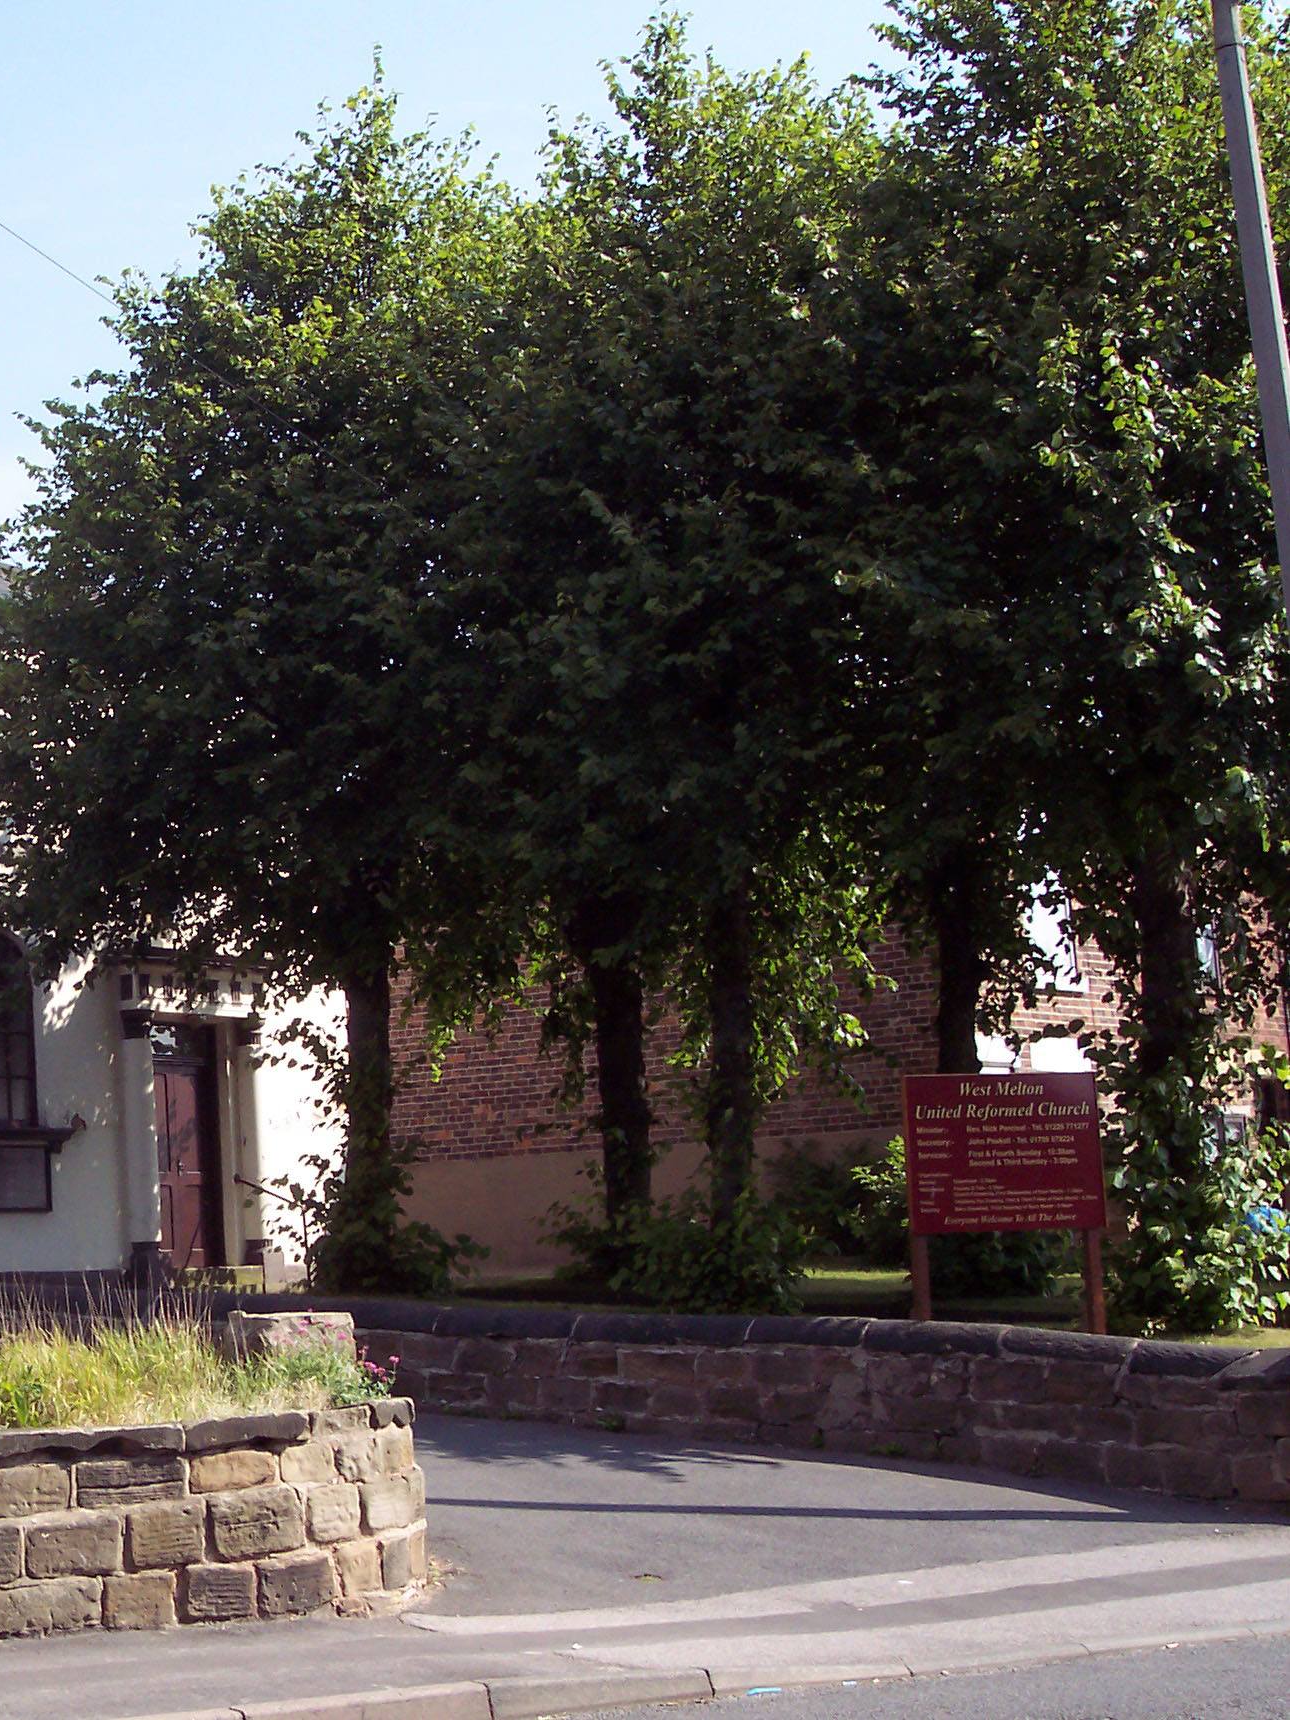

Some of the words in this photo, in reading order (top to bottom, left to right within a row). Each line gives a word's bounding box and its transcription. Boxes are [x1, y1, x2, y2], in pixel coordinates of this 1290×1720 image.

[960, 1082, 991, 1096] West
[995, 1081, 1044, 1096] Melton
[916, 1104, 962, 1120] United
[966, 1102, 1034, 1121] Reformed
[1038, 1100, 1090, 1116] Church
